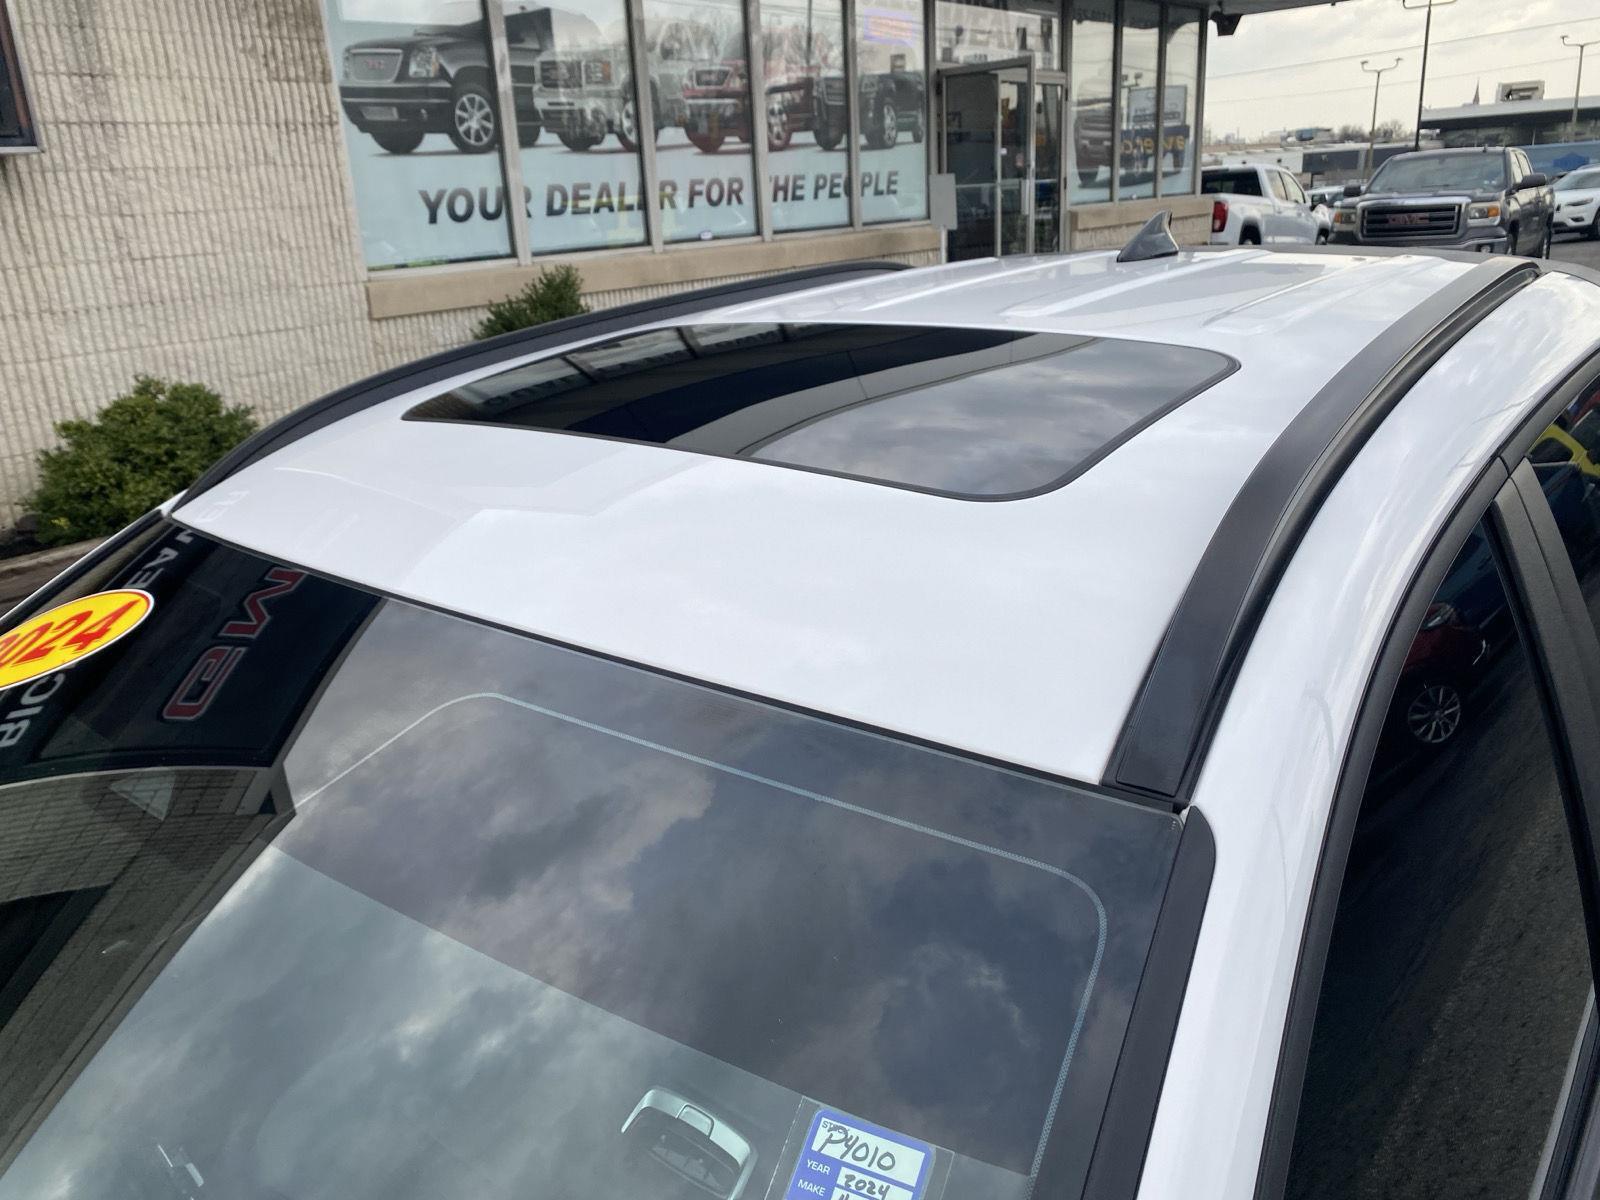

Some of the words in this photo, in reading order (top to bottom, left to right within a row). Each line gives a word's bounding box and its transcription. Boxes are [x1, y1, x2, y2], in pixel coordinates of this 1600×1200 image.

[688, 177, 743, 208] FOR
[769, 174, 806, 203] HE
[818, 1124, 896, 1171] P4010
[797, 1179, 826, 1197] MAKE
[806, 1159, 831, 1175] YEAR
[844, 1174, 891, 1200] 2024
